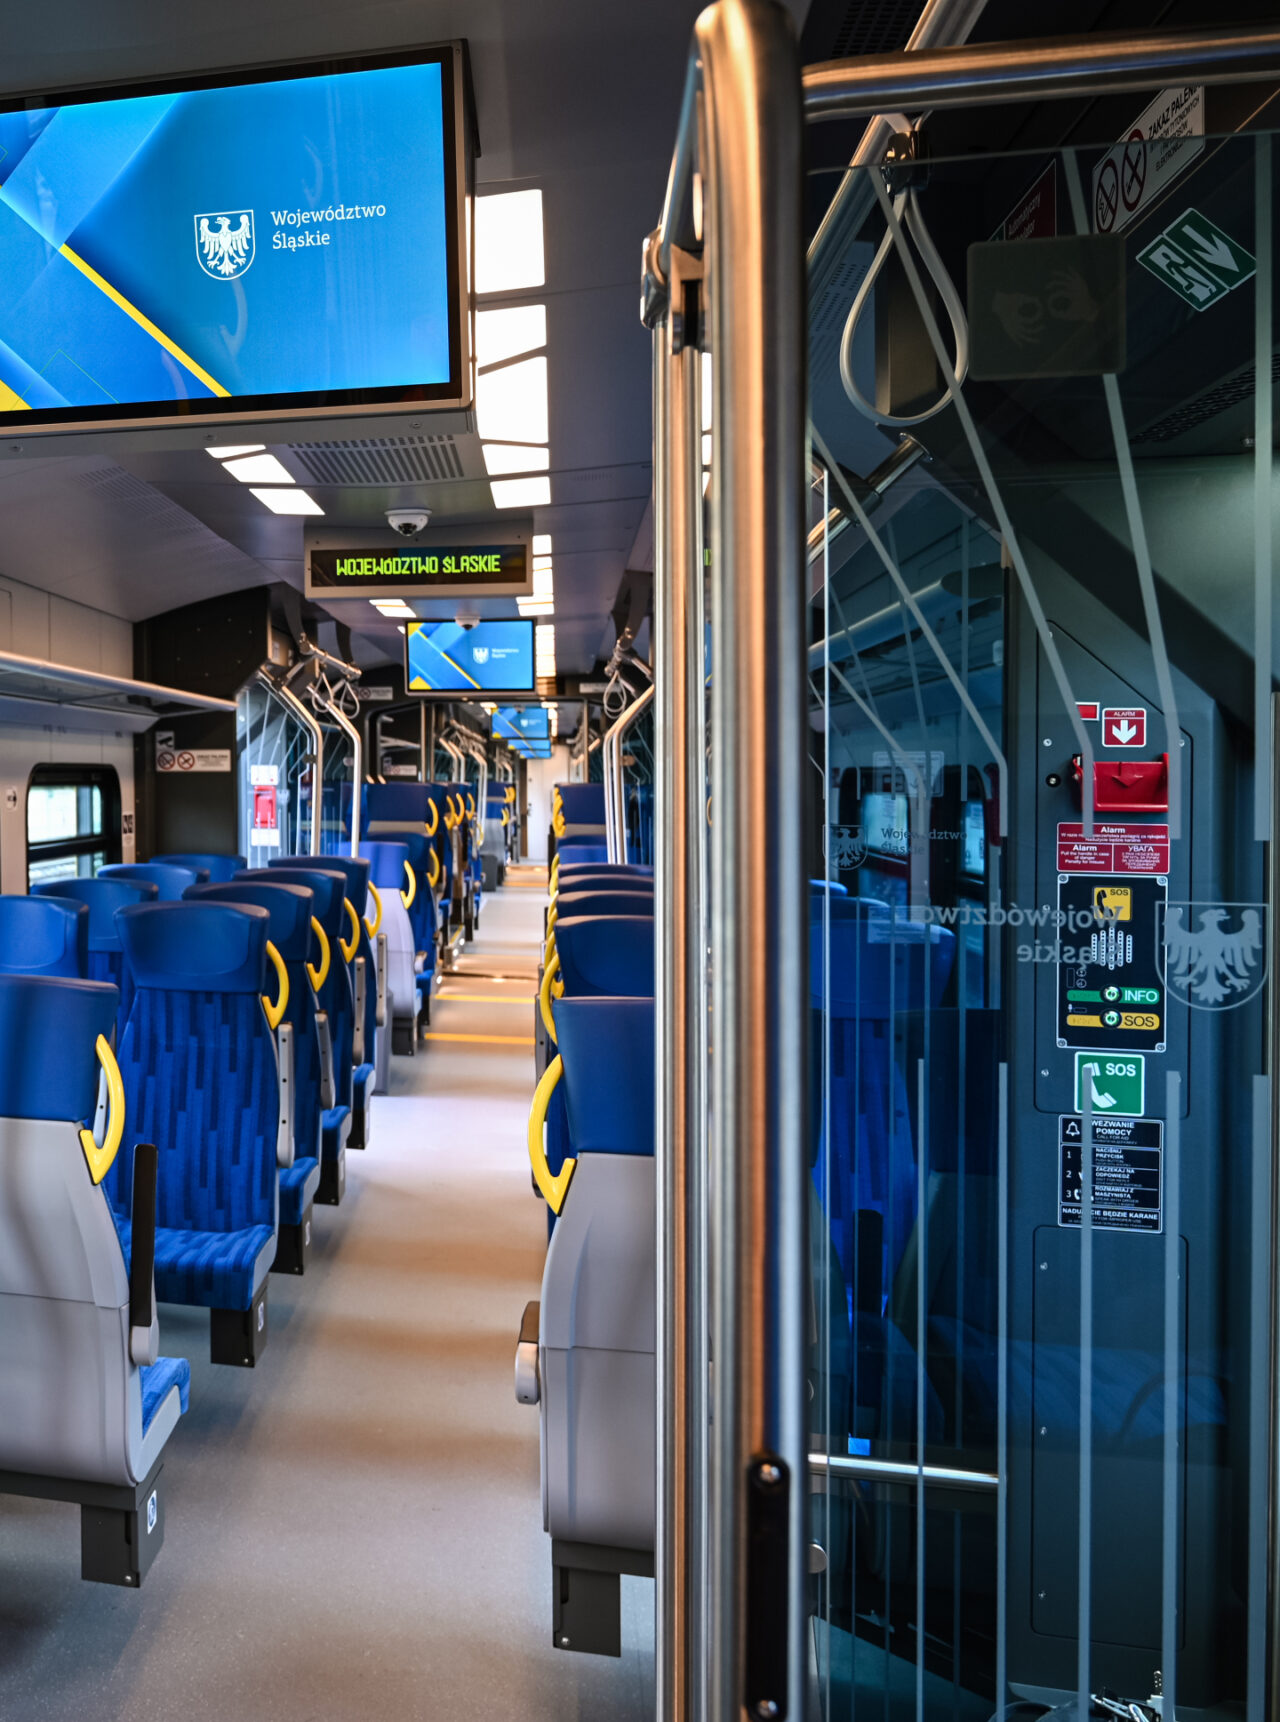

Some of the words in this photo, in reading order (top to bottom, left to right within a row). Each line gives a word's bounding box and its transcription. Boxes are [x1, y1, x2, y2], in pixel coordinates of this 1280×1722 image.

[271, 204, 386, 228] Województwo
[272, 230, 330, 252] Śląskie
[336, 556, 438, 576] WOJEWÓDZTWO
[881, 827, 967, 840] Wojewdztwo
[1101, 826, 1125, 834] Alarm
[1124, 990, 1158, 1002] INFO
[1124, 1015, 1155, 1027] SOS
[1105, 1062, 1136, 1077] SOS
[1091, 1120, 1135, 1128] WEZWANIE
[1096, 1128, 1132, 1136] POMOCY
[1066, 1190, 1072, 1198] 3
[1062, 1207, 1101, 1216] NADUCIE
[1102, 1210, 1127, 1218] BĘDZIE
[1129, 1212, 1158, 1220] KARANE
